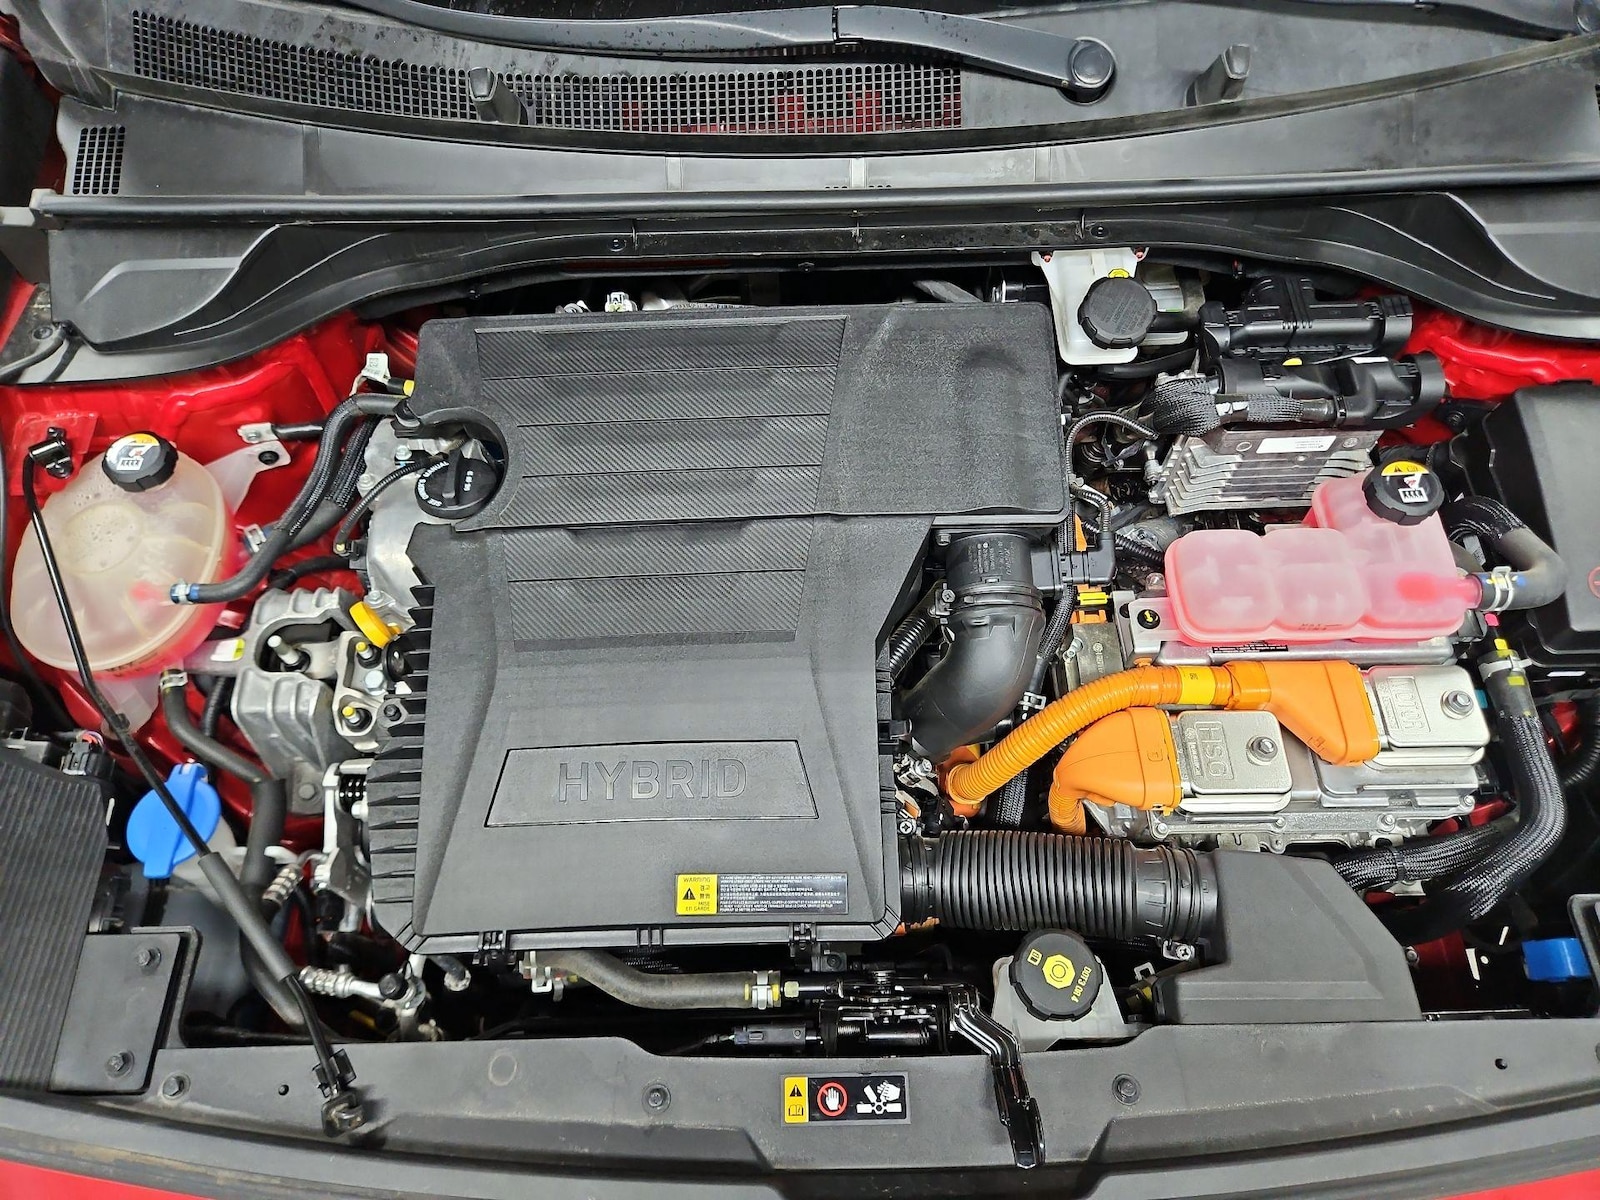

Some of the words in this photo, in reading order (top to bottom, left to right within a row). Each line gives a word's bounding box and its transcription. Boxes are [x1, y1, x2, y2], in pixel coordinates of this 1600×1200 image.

[423, 461, 450, 477] MANUAL
[1200, 723, 1229, 779] HSG
[557, 758, 748, 803] HYBRID
